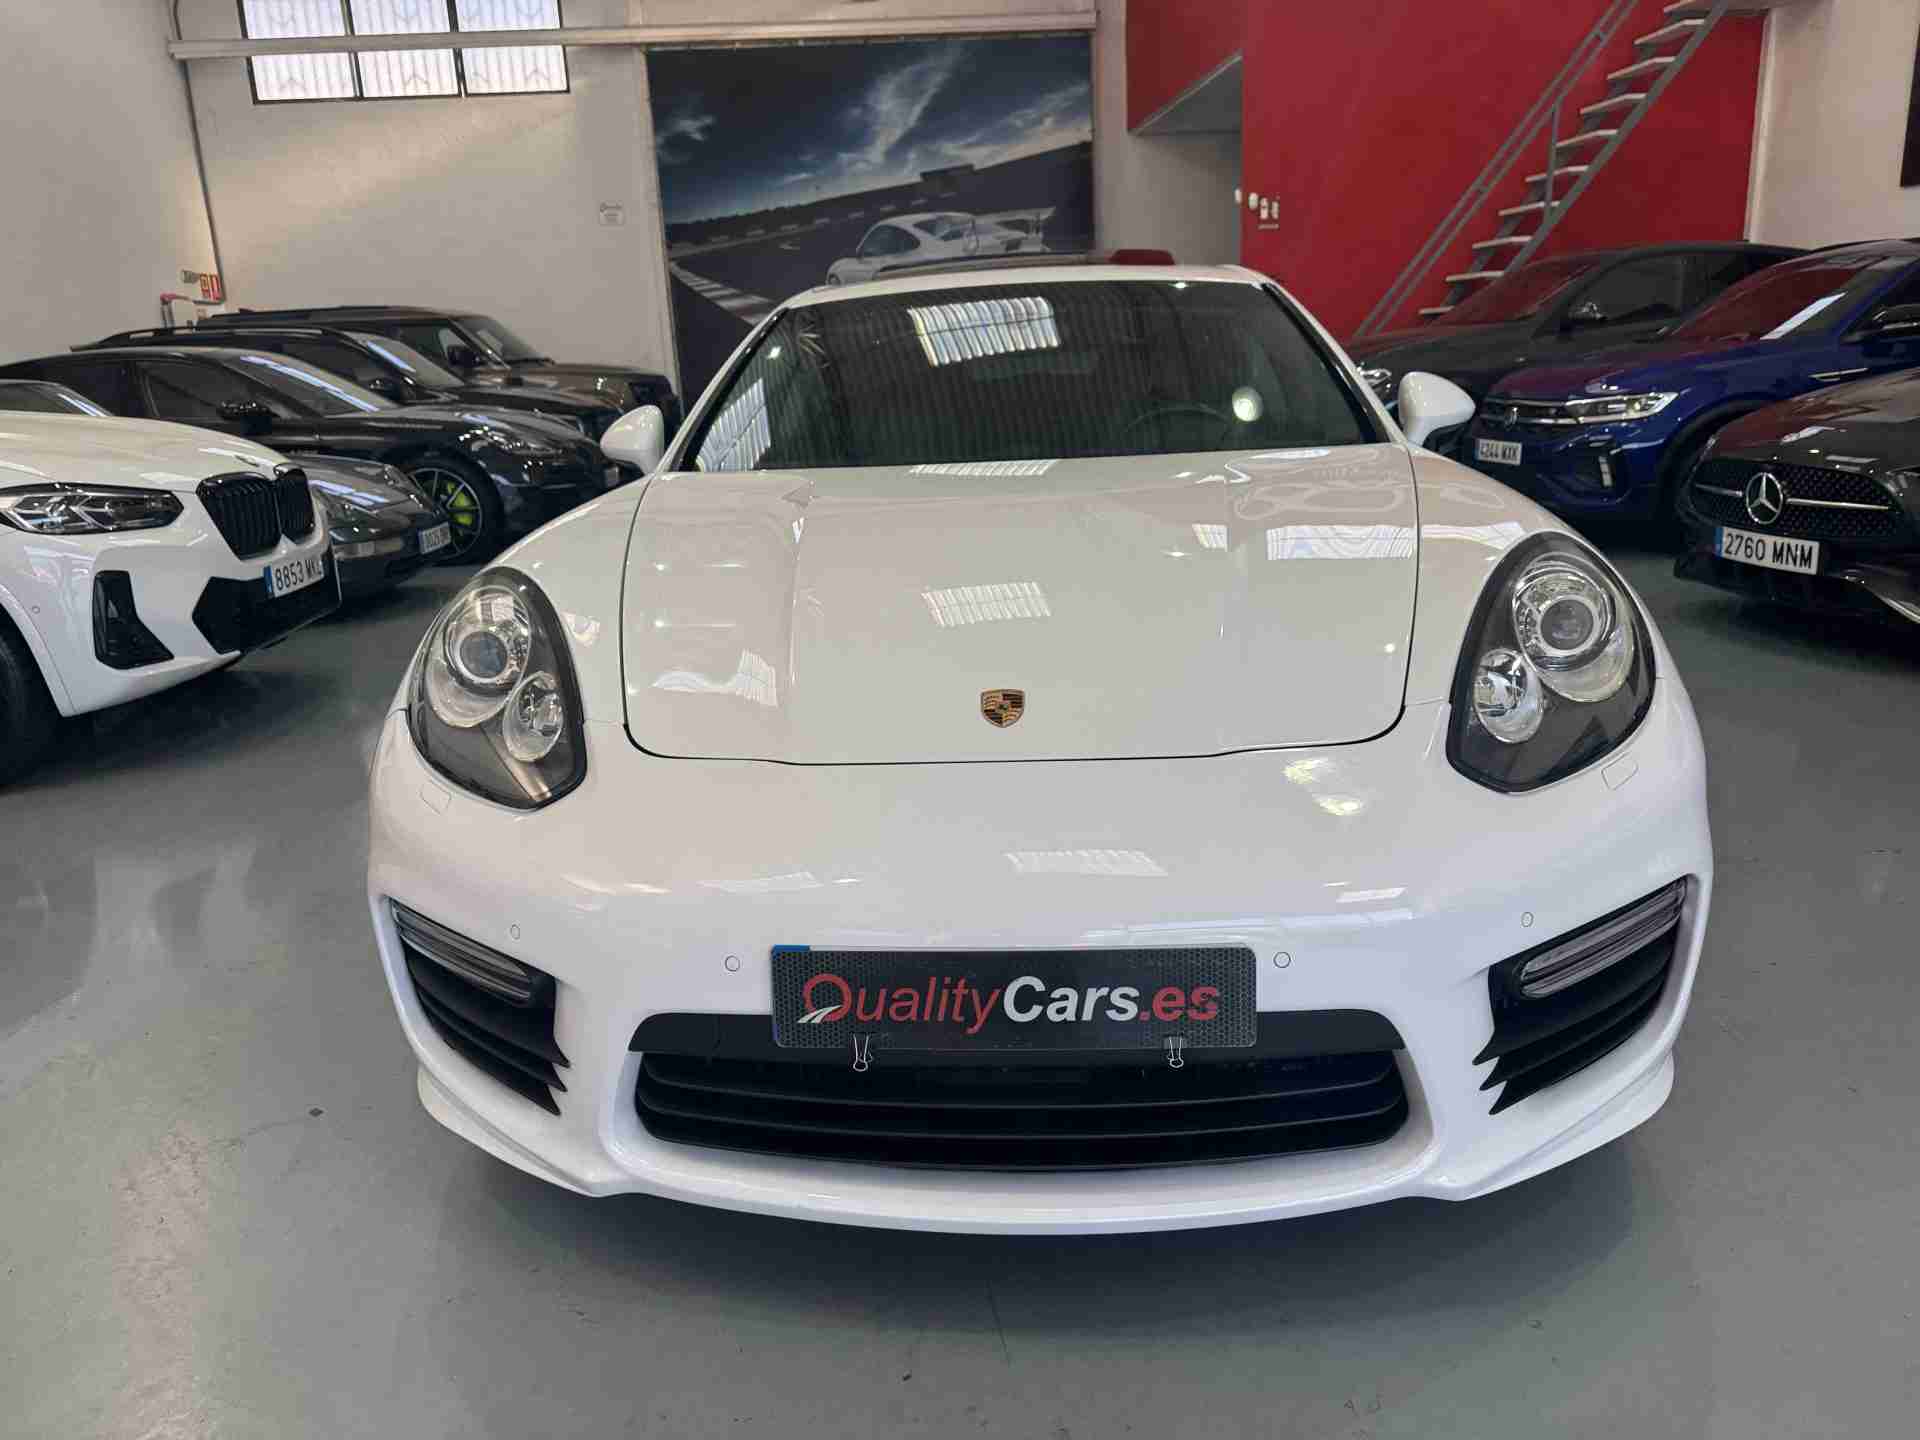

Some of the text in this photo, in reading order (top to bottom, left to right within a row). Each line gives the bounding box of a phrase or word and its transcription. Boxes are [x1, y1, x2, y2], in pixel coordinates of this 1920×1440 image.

[1725, 533, 1813, 569] 2760 MNM
[275, 560, 304, 591] 8853
[797, 973, 1220, 1034] QualityCars.es
